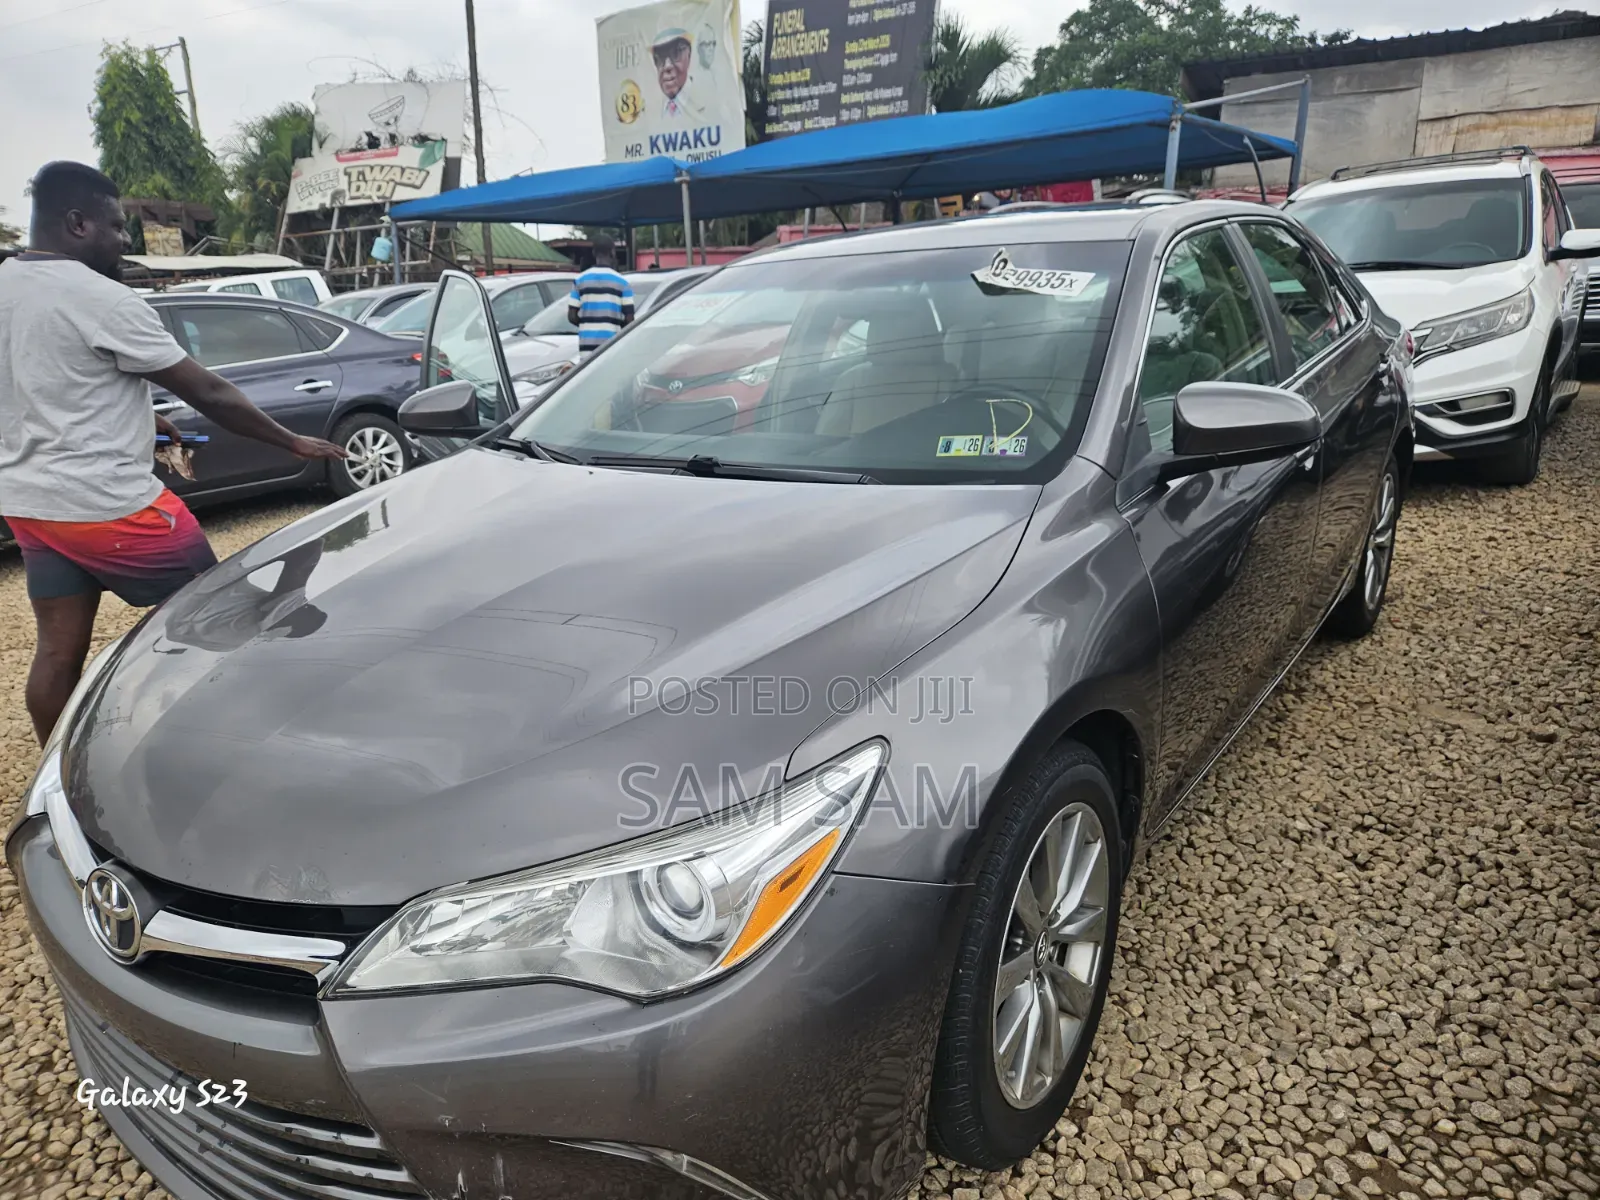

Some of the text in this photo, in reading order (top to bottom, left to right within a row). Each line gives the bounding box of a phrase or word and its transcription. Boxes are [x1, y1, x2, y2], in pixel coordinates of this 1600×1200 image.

[773, 8, 805, 36] FUNERAL
[770, 28, 830, 60] ARRANGEMENTS
[620, 93, 639, 117] 83
[624, 124, 721, 159] MR. KWAKU
[344, 164, 429, 189] TWABI
[967, 438, 980, 452] 26
[1013, 439, 1026, 453] 26
